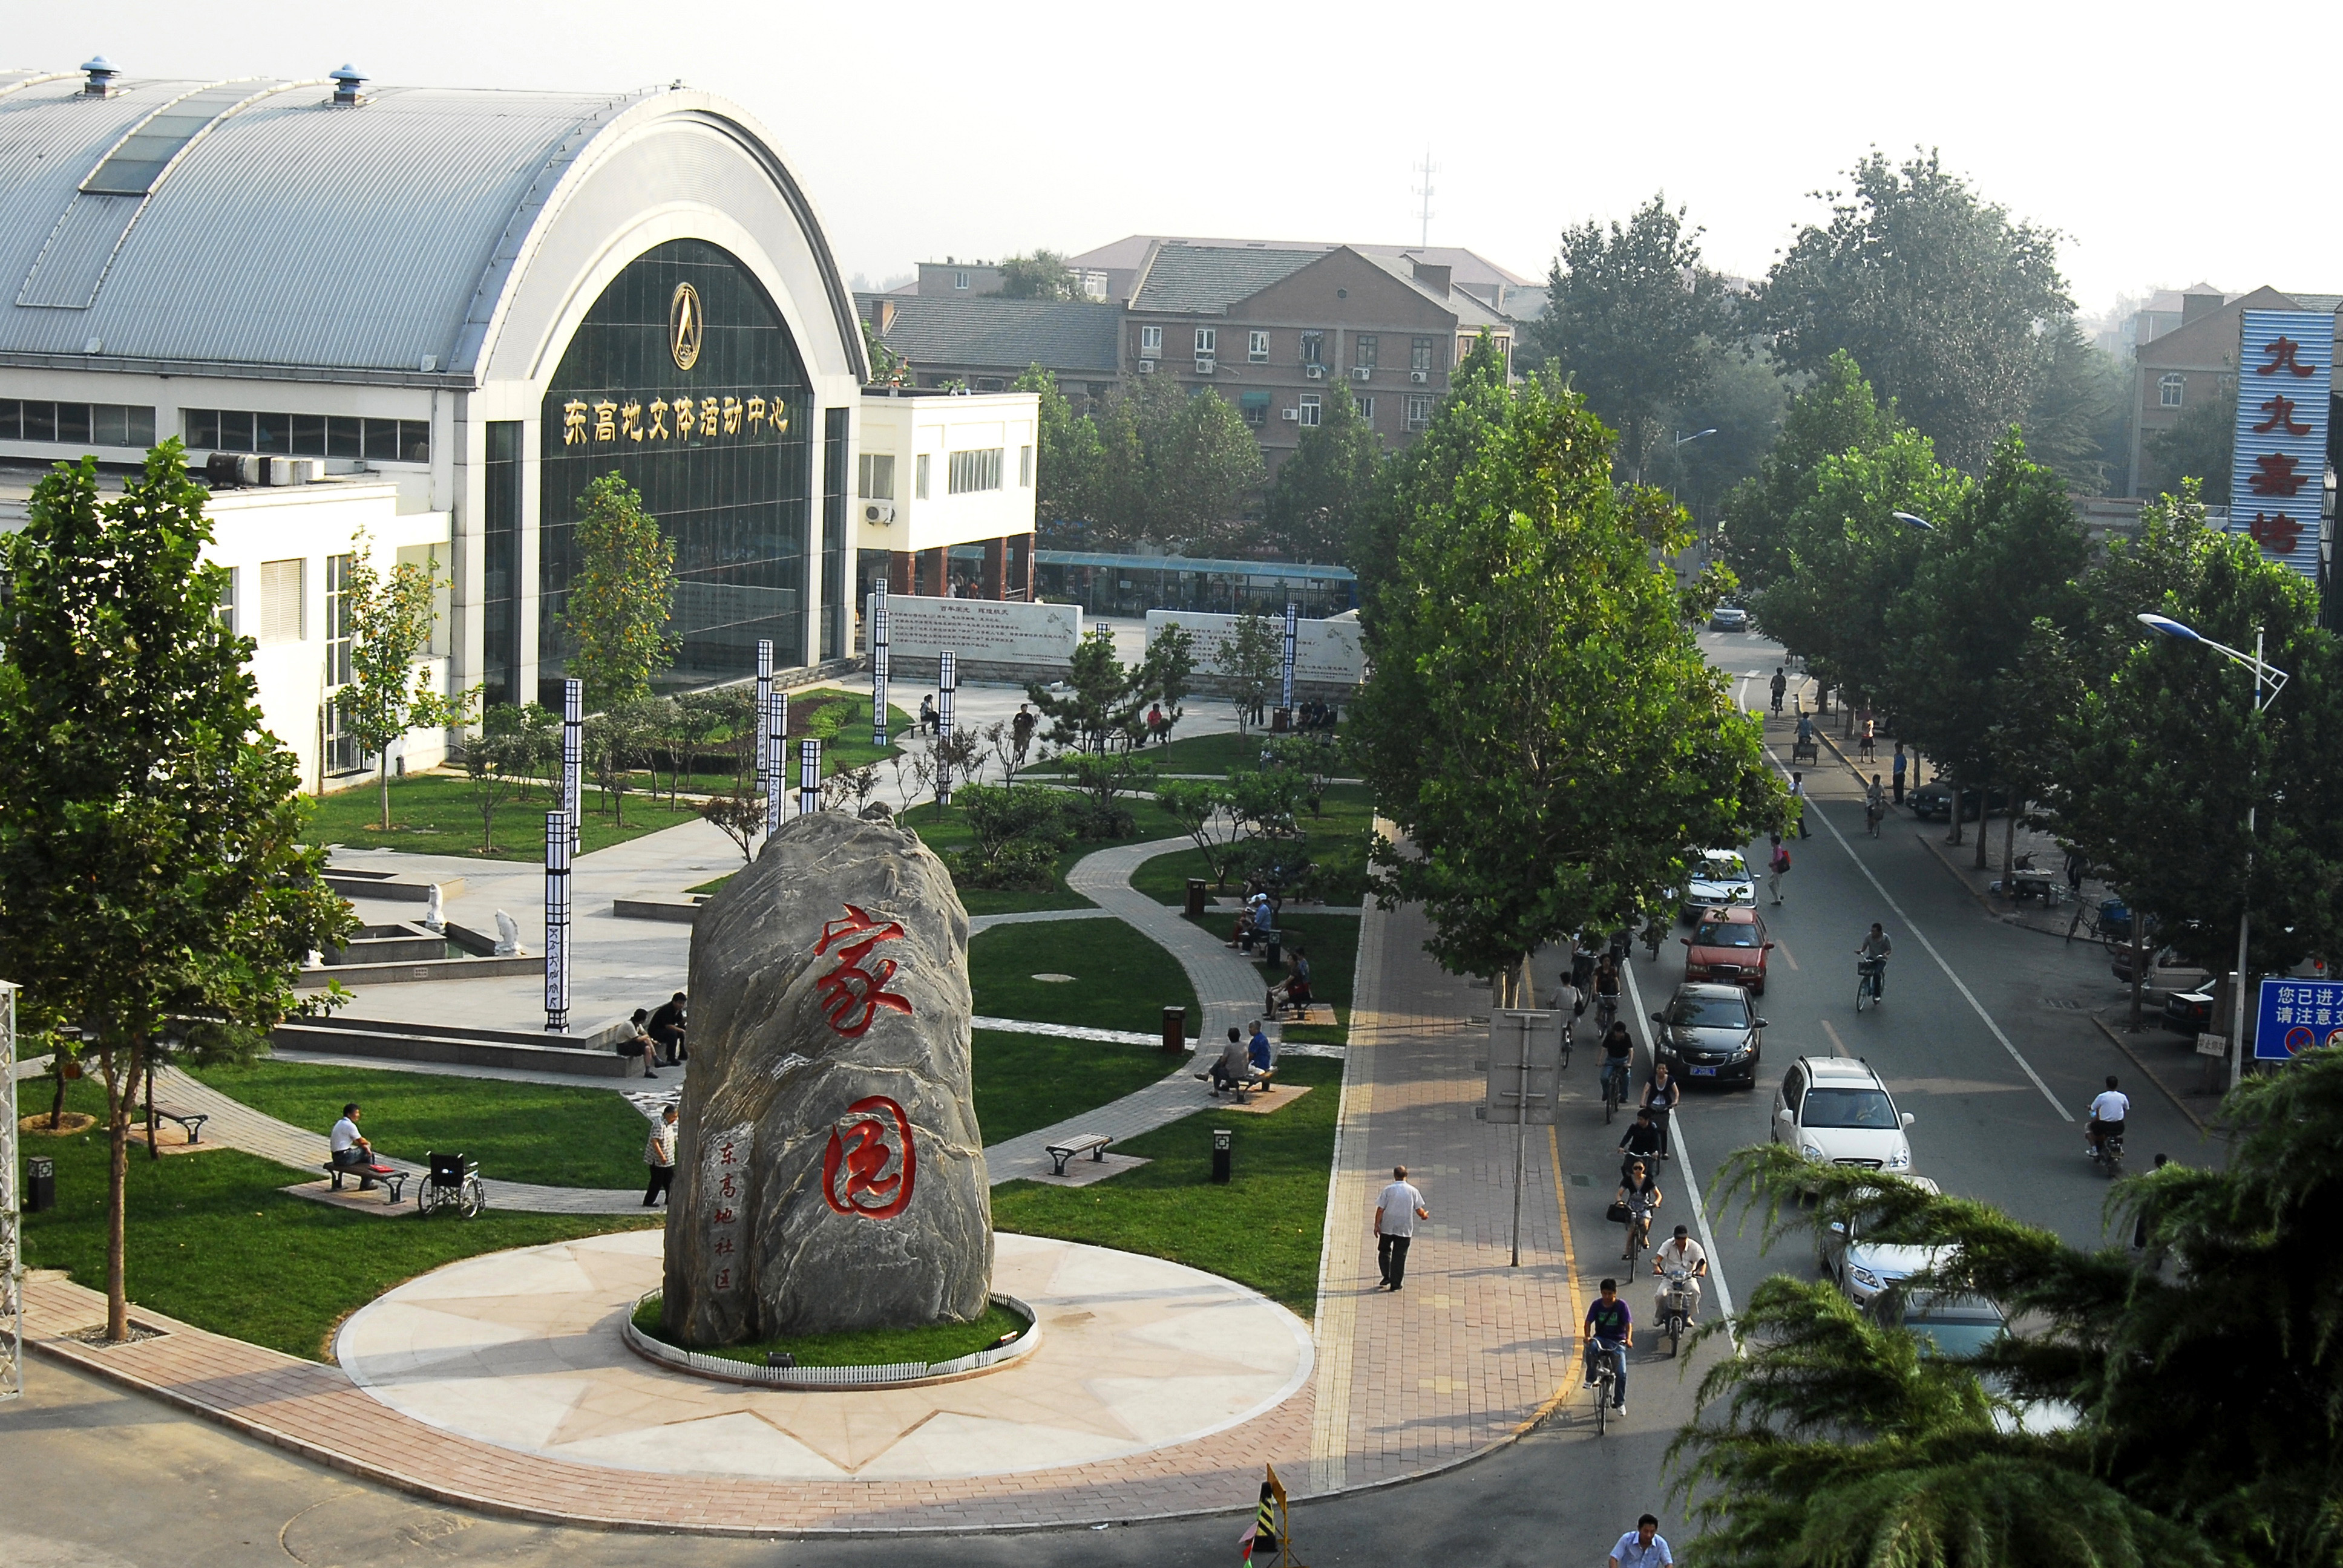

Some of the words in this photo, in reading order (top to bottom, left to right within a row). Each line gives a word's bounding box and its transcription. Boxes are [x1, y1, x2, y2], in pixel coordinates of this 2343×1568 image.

[563, 394, 788, 446] 东高地文体活动中心
[714, 1142, 736, 1290] 东高地社区
